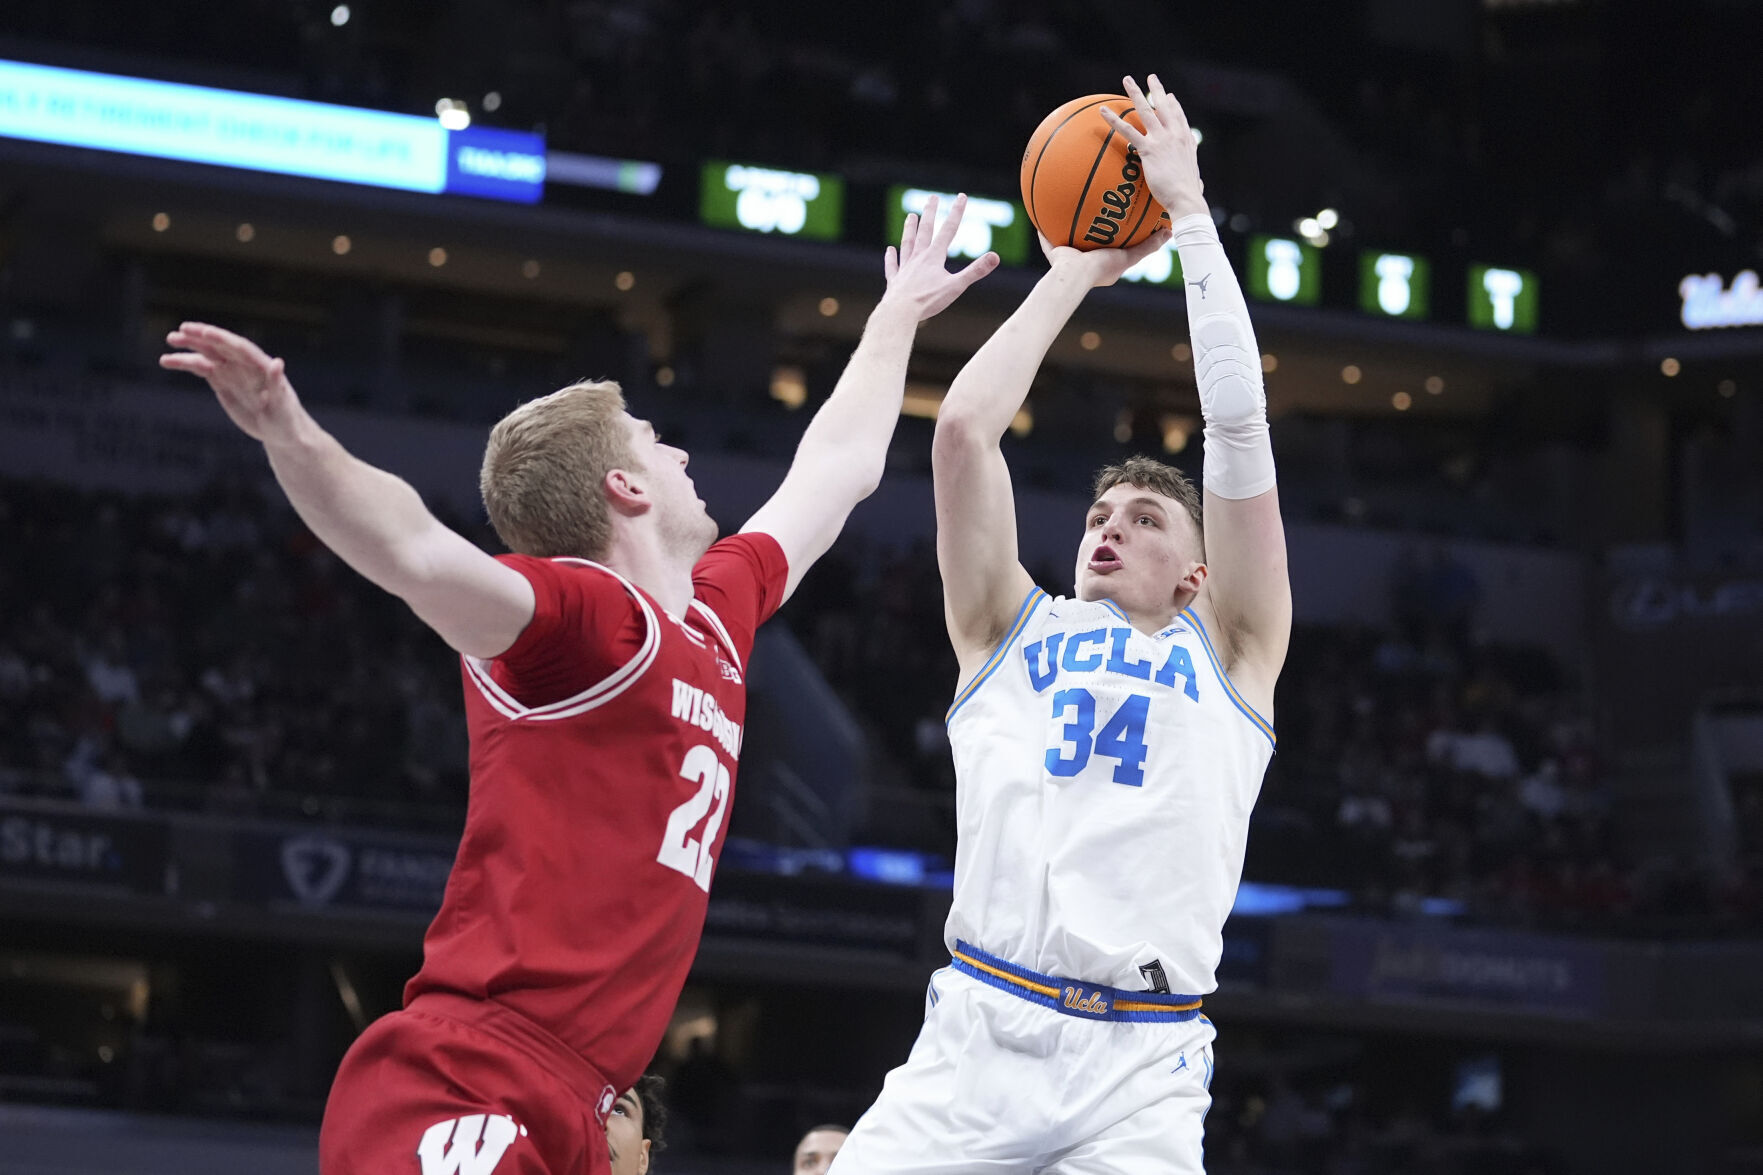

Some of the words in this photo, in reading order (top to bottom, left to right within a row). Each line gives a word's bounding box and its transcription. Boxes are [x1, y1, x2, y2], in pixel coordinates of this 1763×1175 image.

[1023, 627, 1199, 704] UCLA
[1044, 688, 1150, 787] 34
[656, 744, 730, 893] 22
[1064, 986, 1107, 1014] Ucla
[417, 1113, 518, 1175] W
